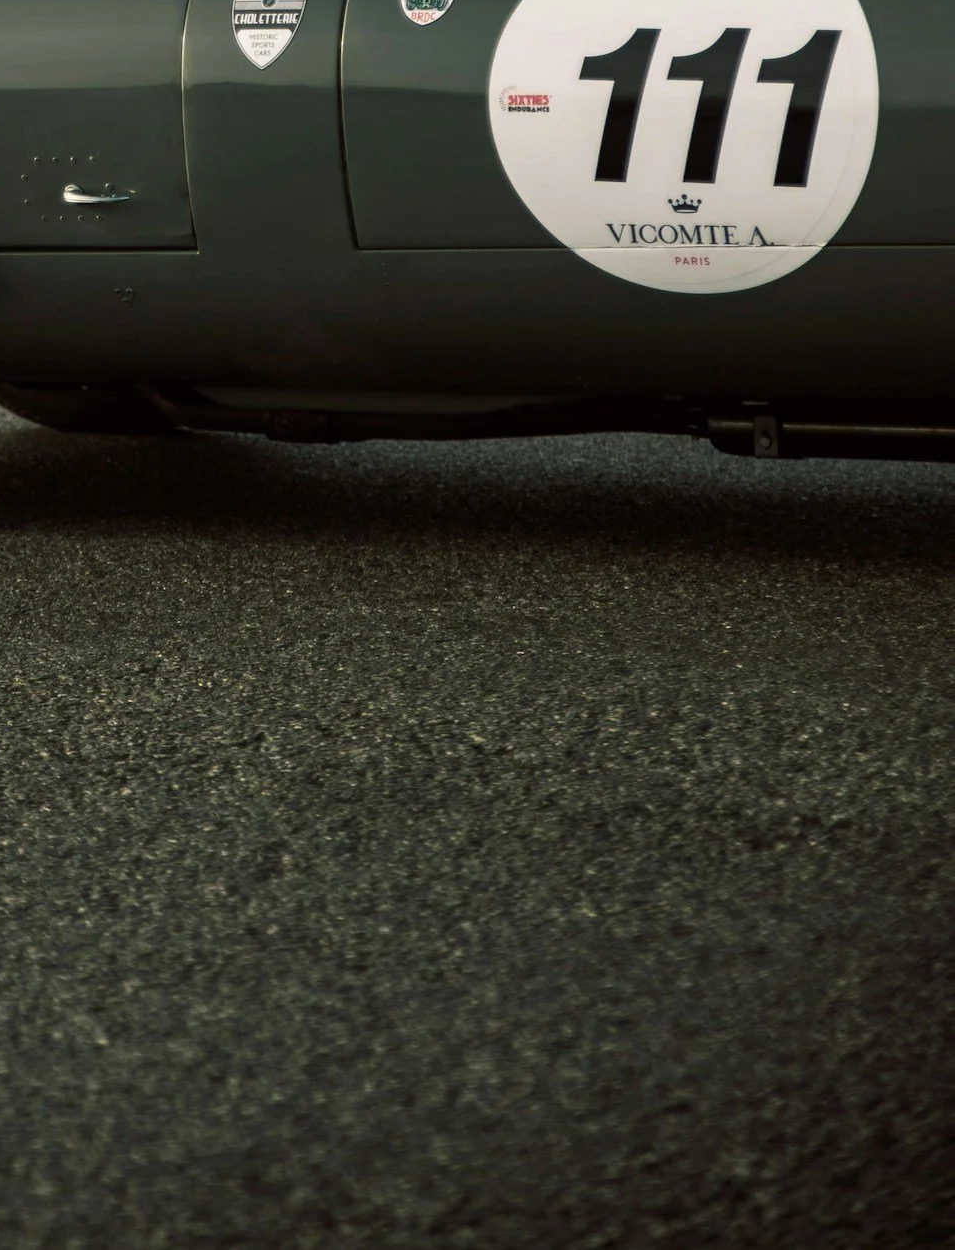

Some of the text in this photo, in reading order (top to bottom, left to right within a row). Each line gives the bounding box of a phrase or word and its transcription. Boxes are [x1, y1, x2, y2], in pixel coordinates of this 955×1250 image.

[235, 13, 299, 24] CHOLETTERIE
[411, 12, 436, 22] BRDC
[578, 28, 842, 187] 111
[606, 224, 739, 245] VICOMTE
[675, 257, 711, 266] PARIS
